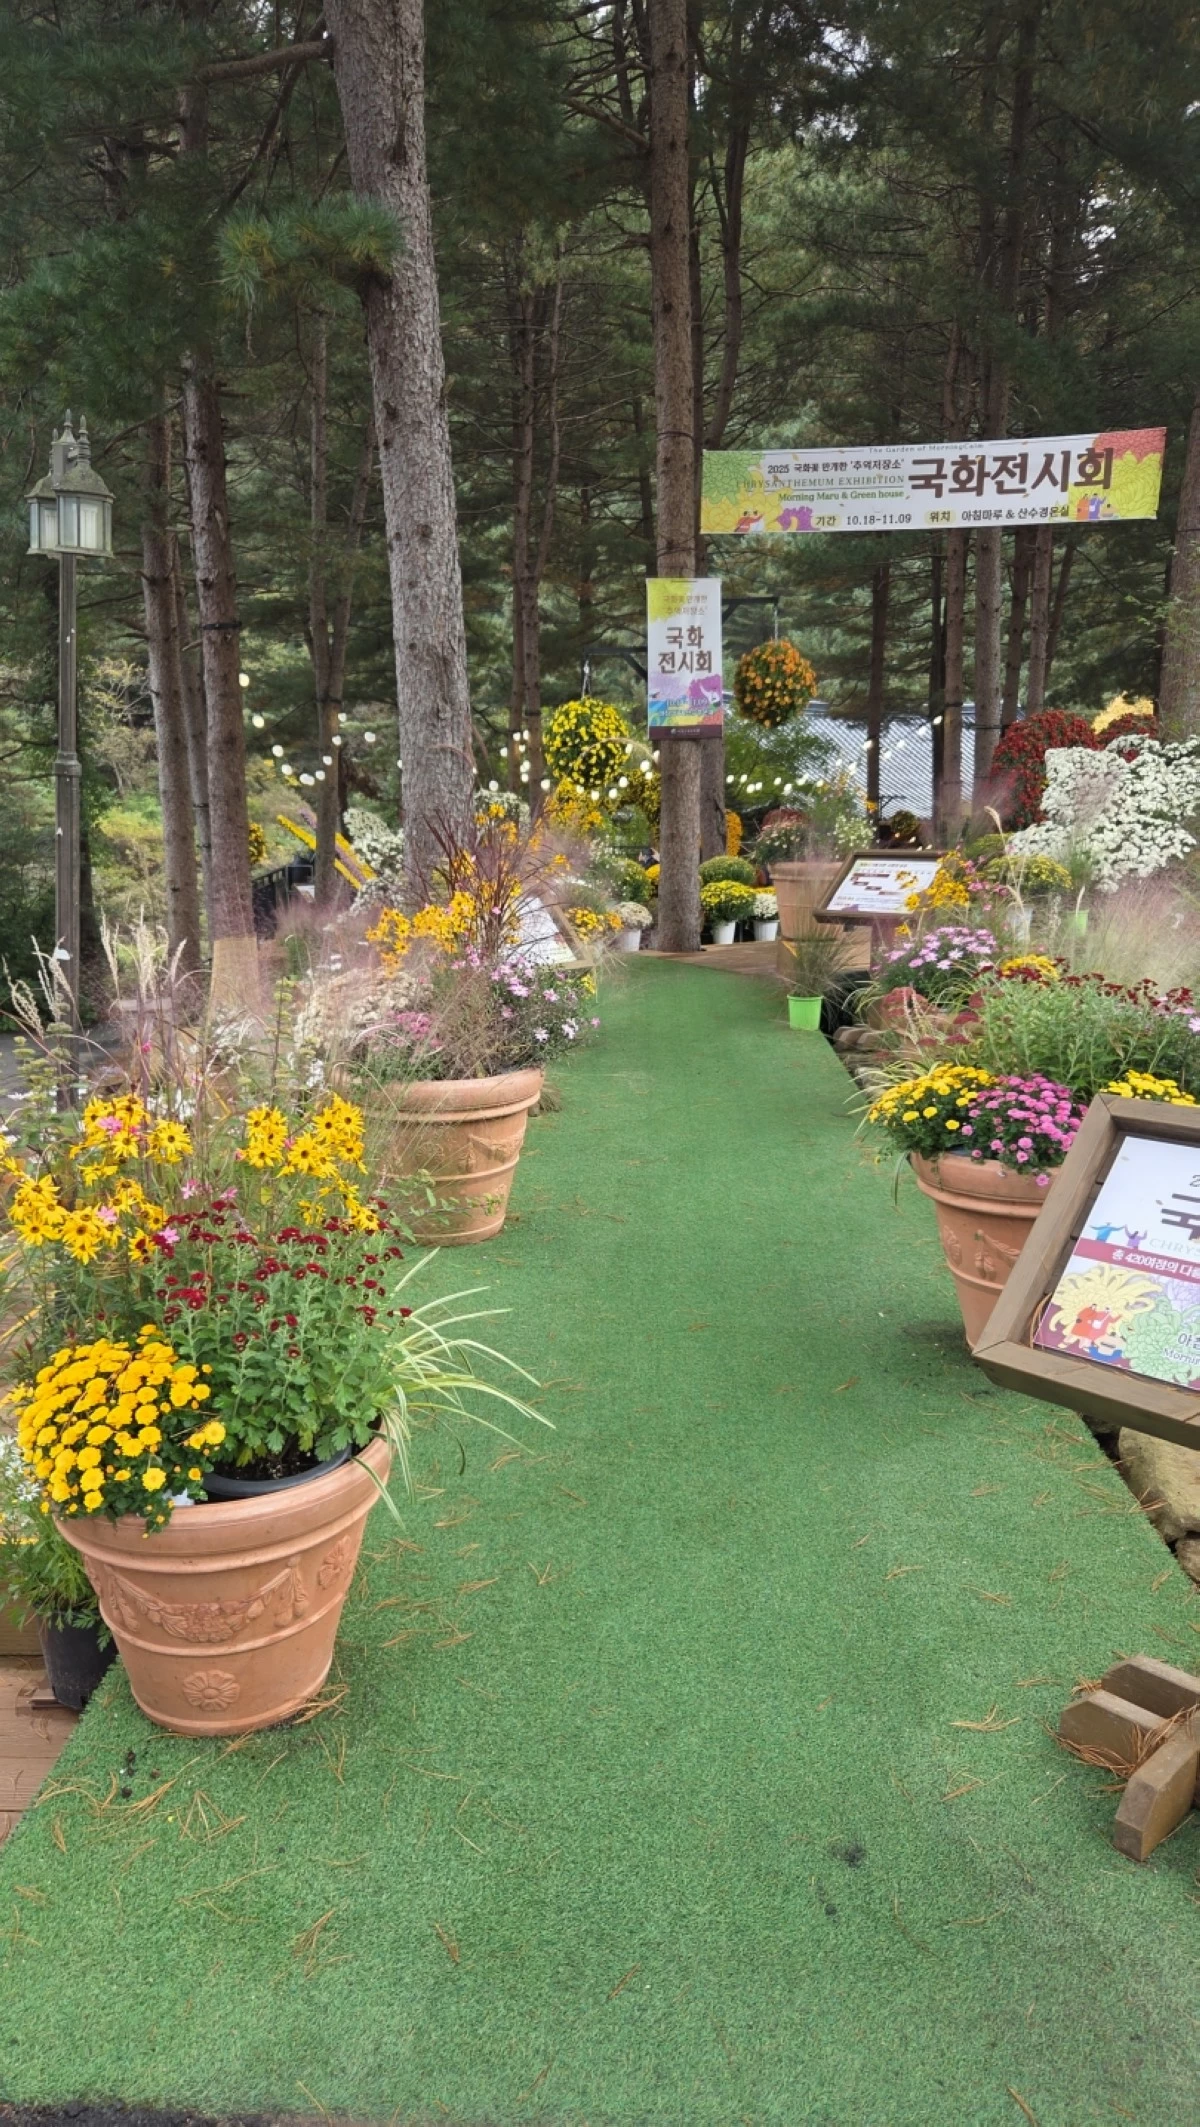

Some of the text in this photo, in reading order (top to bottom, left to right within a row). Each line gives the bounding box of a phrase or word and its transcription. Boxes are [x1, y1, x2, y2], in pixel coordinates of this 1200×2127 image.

[767, 464, 790, 475] 2025
[908, 447, 1114, 499] 국화전시회
[839, 475, 904, 486] EXHIBITION
[779, 492, 814, 501] Morning
[817, 491, 840, 500] Maru
[850, 490, 877, 499] Green
[879, 490, 904, 498] house
[816, 513, 912, 527] 기간 10.18-11.09
[929, 510, 951, 523] 위치
[961, 509, 1003, 522] 아침마루
[665, 625, 705, 650] 국화
[657, 651, 713, 674] 전시회
